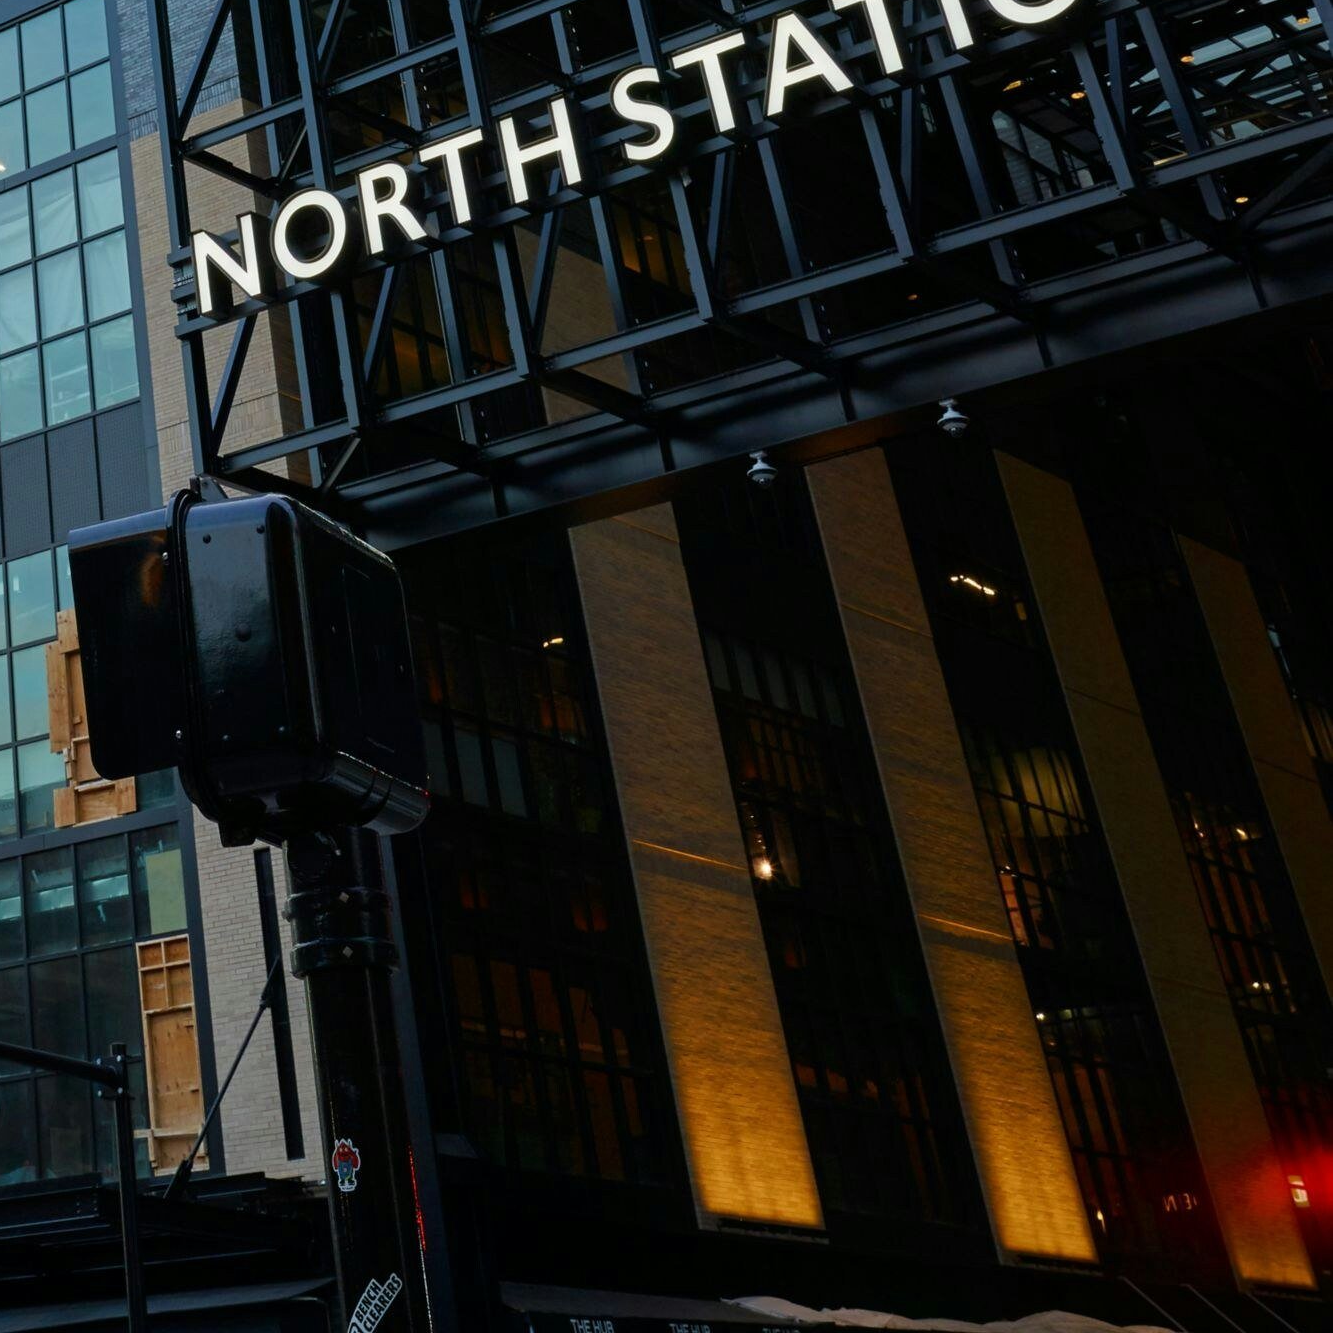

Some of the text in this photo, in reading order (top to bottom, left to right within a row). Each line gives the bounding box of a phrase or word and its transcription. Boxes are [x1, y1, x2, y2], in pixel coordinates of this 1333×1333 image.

[192, 96, 585, 316] NORTH
[354, 1281, 381, 1324] BENCH
[363, 1275, 400, 1333] CLEARERS
[570, 1319, 592, 1333] THE
